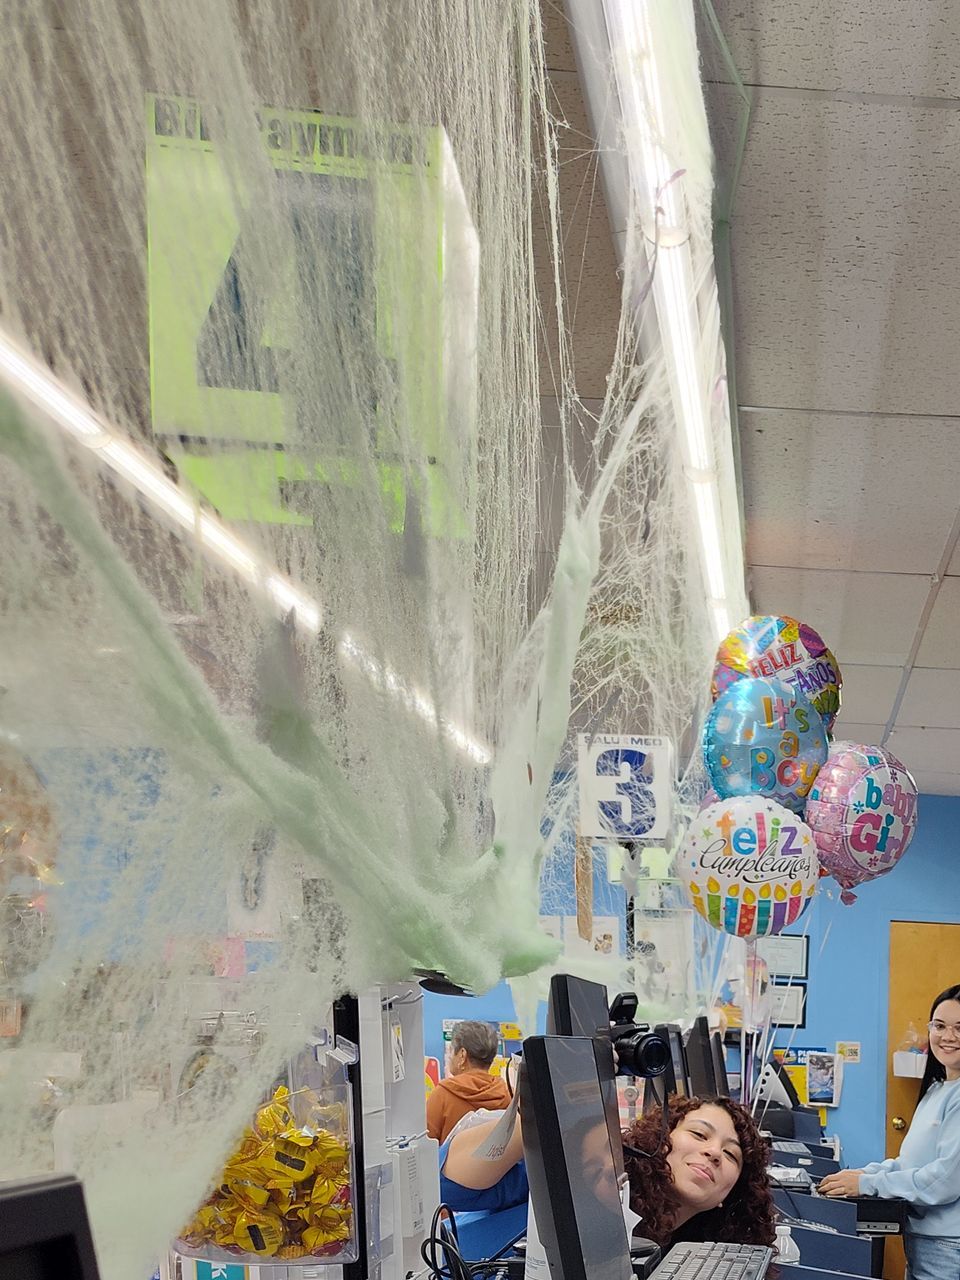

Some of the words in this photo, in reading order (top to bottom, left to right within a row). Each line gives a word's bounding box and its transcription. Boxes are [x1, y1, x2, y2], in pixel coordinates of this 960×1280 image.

[750, 643, 804, 678] FELIZ
[762, 696, 810, 733] It's
[780, 731, 799, 758] a
[596, 749, 656, 836] 3
[751, 748, 821, 797] Boy
[865, 777, 917, 825] baby
[716, 810, 803, 856] feliz
[850, 812, 911, 864] Girl
